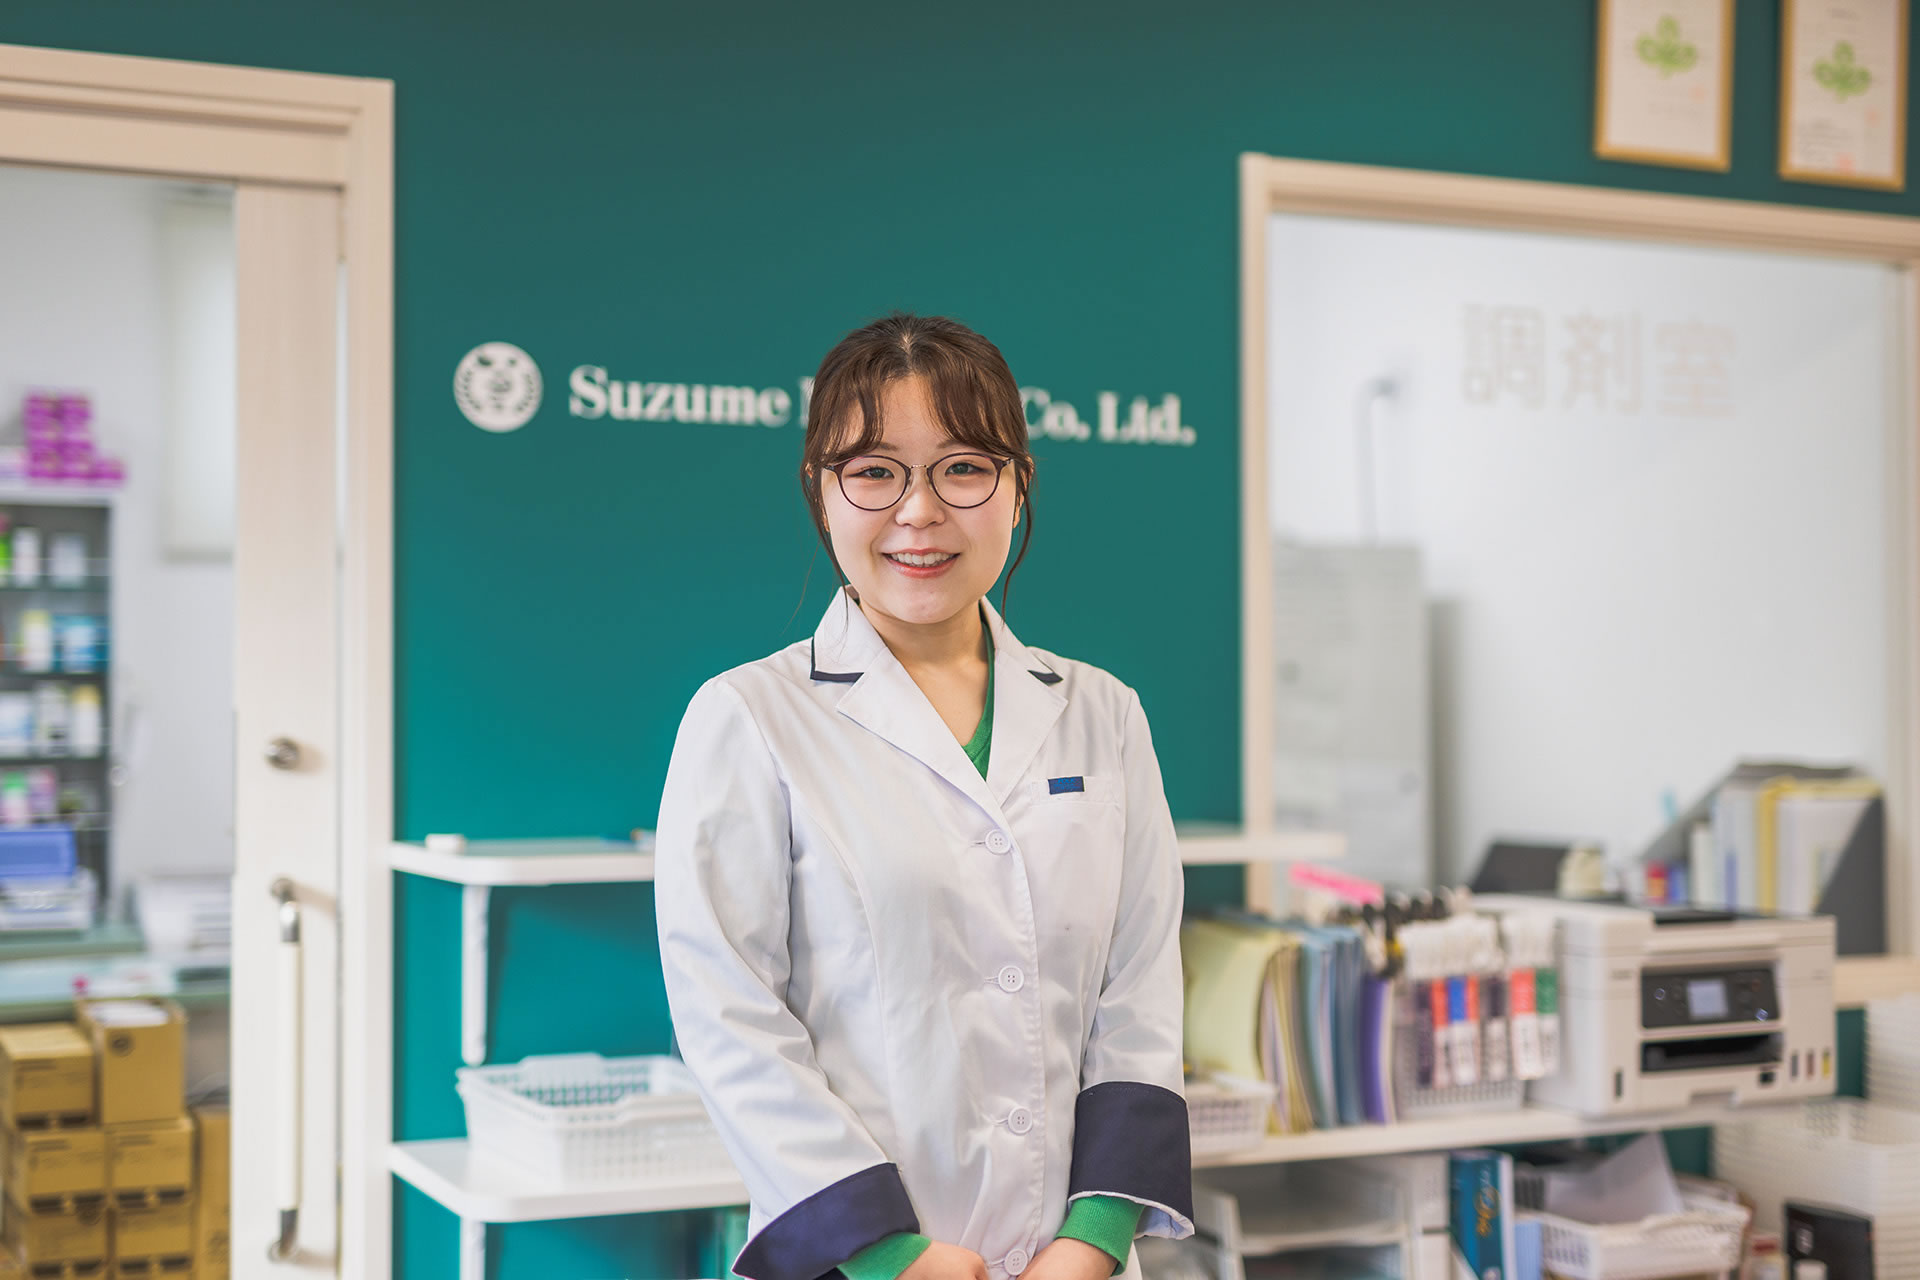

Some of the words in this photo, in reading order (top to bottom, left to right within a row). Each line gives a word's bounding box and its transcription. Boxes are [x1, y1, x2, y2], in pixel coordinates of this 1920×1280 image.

[569, 364, 791, 428] Suzume
[1098, 391, 1197, 446] Ltd.
[1459, 303, 1738, 419] 調剤室
